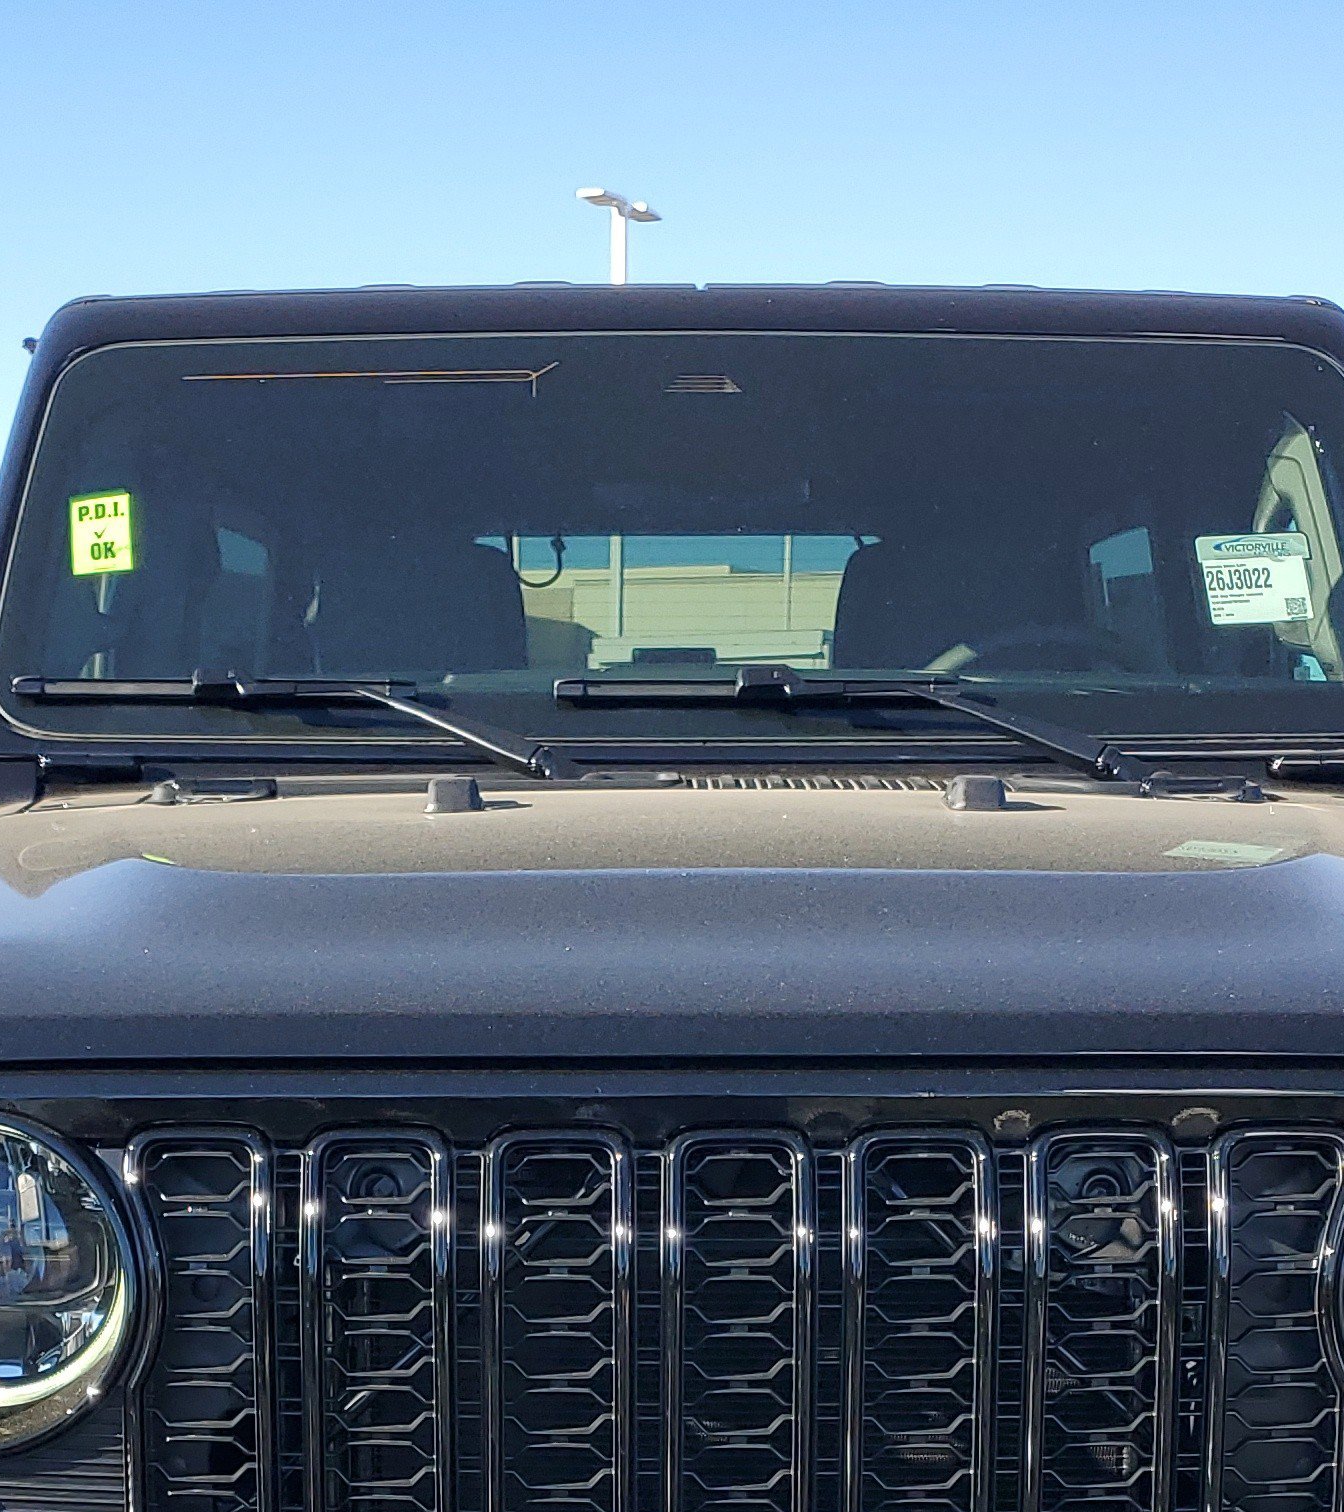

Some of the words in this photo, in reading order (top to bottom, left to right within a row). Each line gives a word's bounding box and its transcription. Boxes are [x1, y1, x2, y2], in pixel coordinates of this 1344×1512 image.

[77, 501, 125, 522] P.D.I.
[90, 541, 117, 561] OK
[1224, 541, 1287, 553] VICTORVILLE
[1205, 567, 1273, 592] 26J3022
